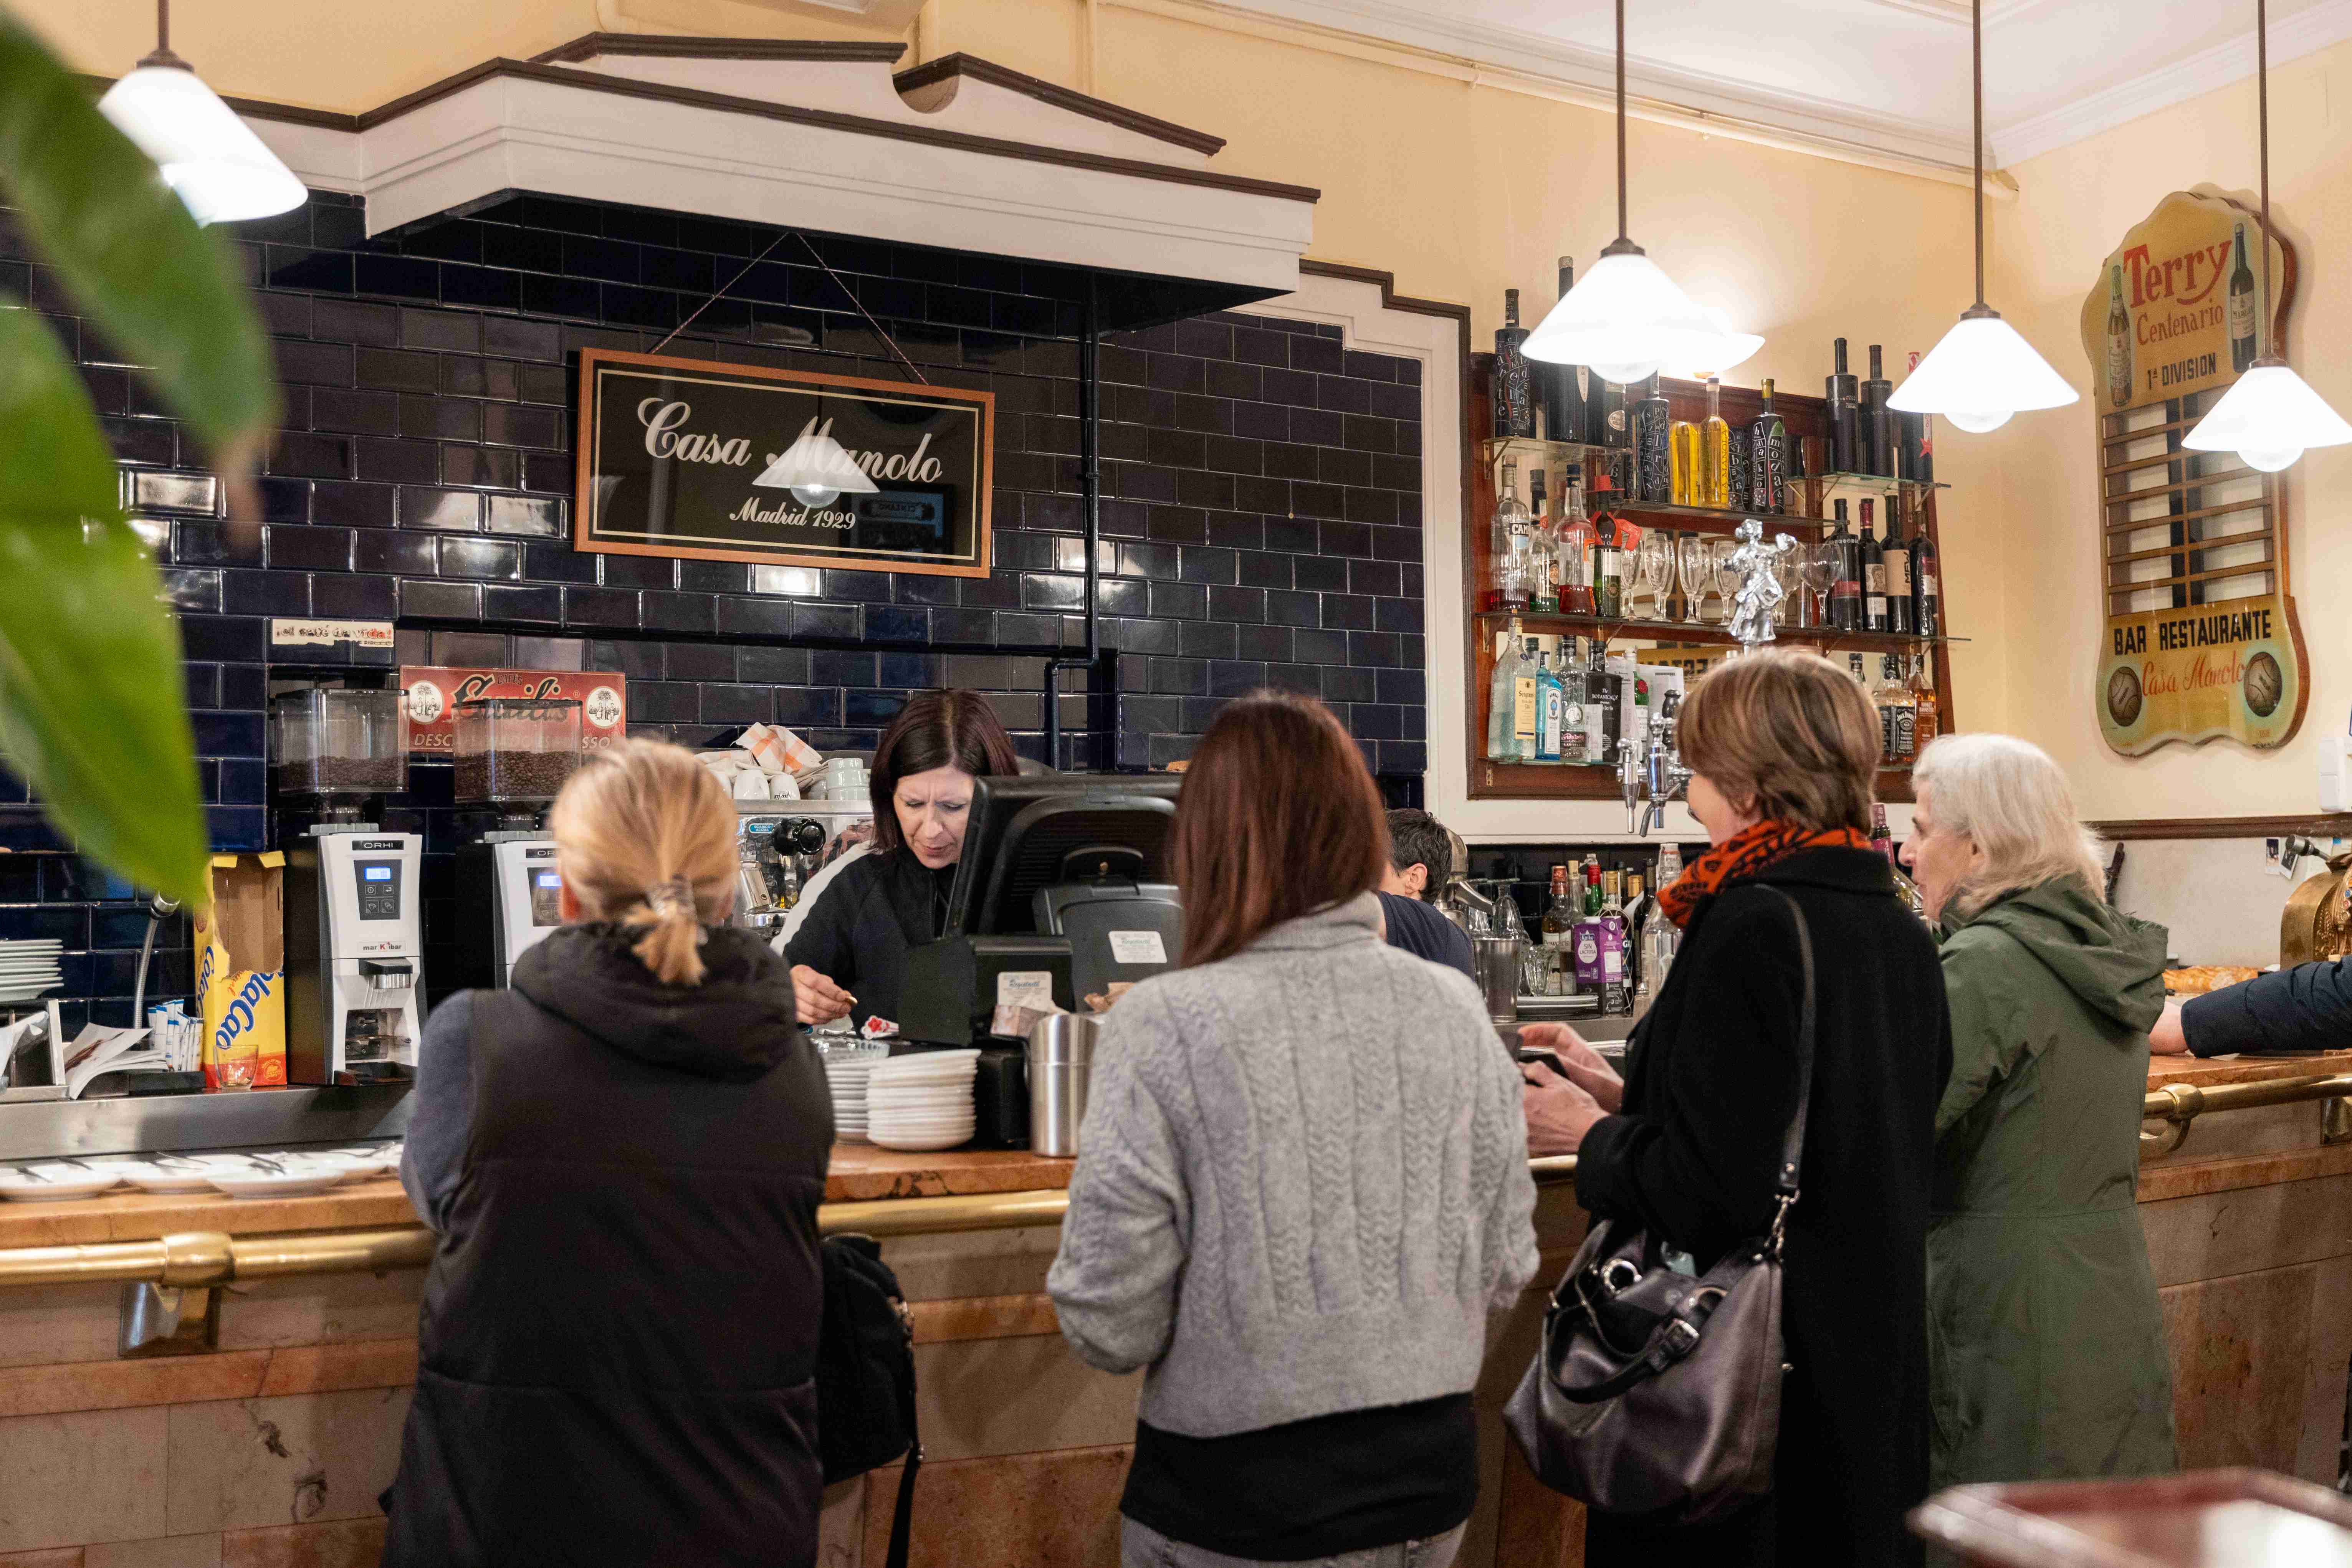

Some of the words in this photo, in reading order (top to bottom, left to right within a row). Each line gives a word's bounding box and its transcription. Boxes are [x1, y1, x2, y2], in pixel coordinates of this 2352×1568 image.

[2123, 240, 2232, 309] Terry
[2136, 299, 2224, 346] Centenario
[2162, 352, 2216, 385] DIVISION
[637, 397, 752, 466] Casa
[766, 415, 943, 483] Manolo
[729, 497, 810, 527] Madrid
[811, 510, 856, 529] 1929
[2114, 625, 2147, 656] BAR
[2160, 609, 2271, 650] RESTAURANTE
[2141, 661, 2178, 697] Casa
[2183, 650, 2246, 690] Manolo
